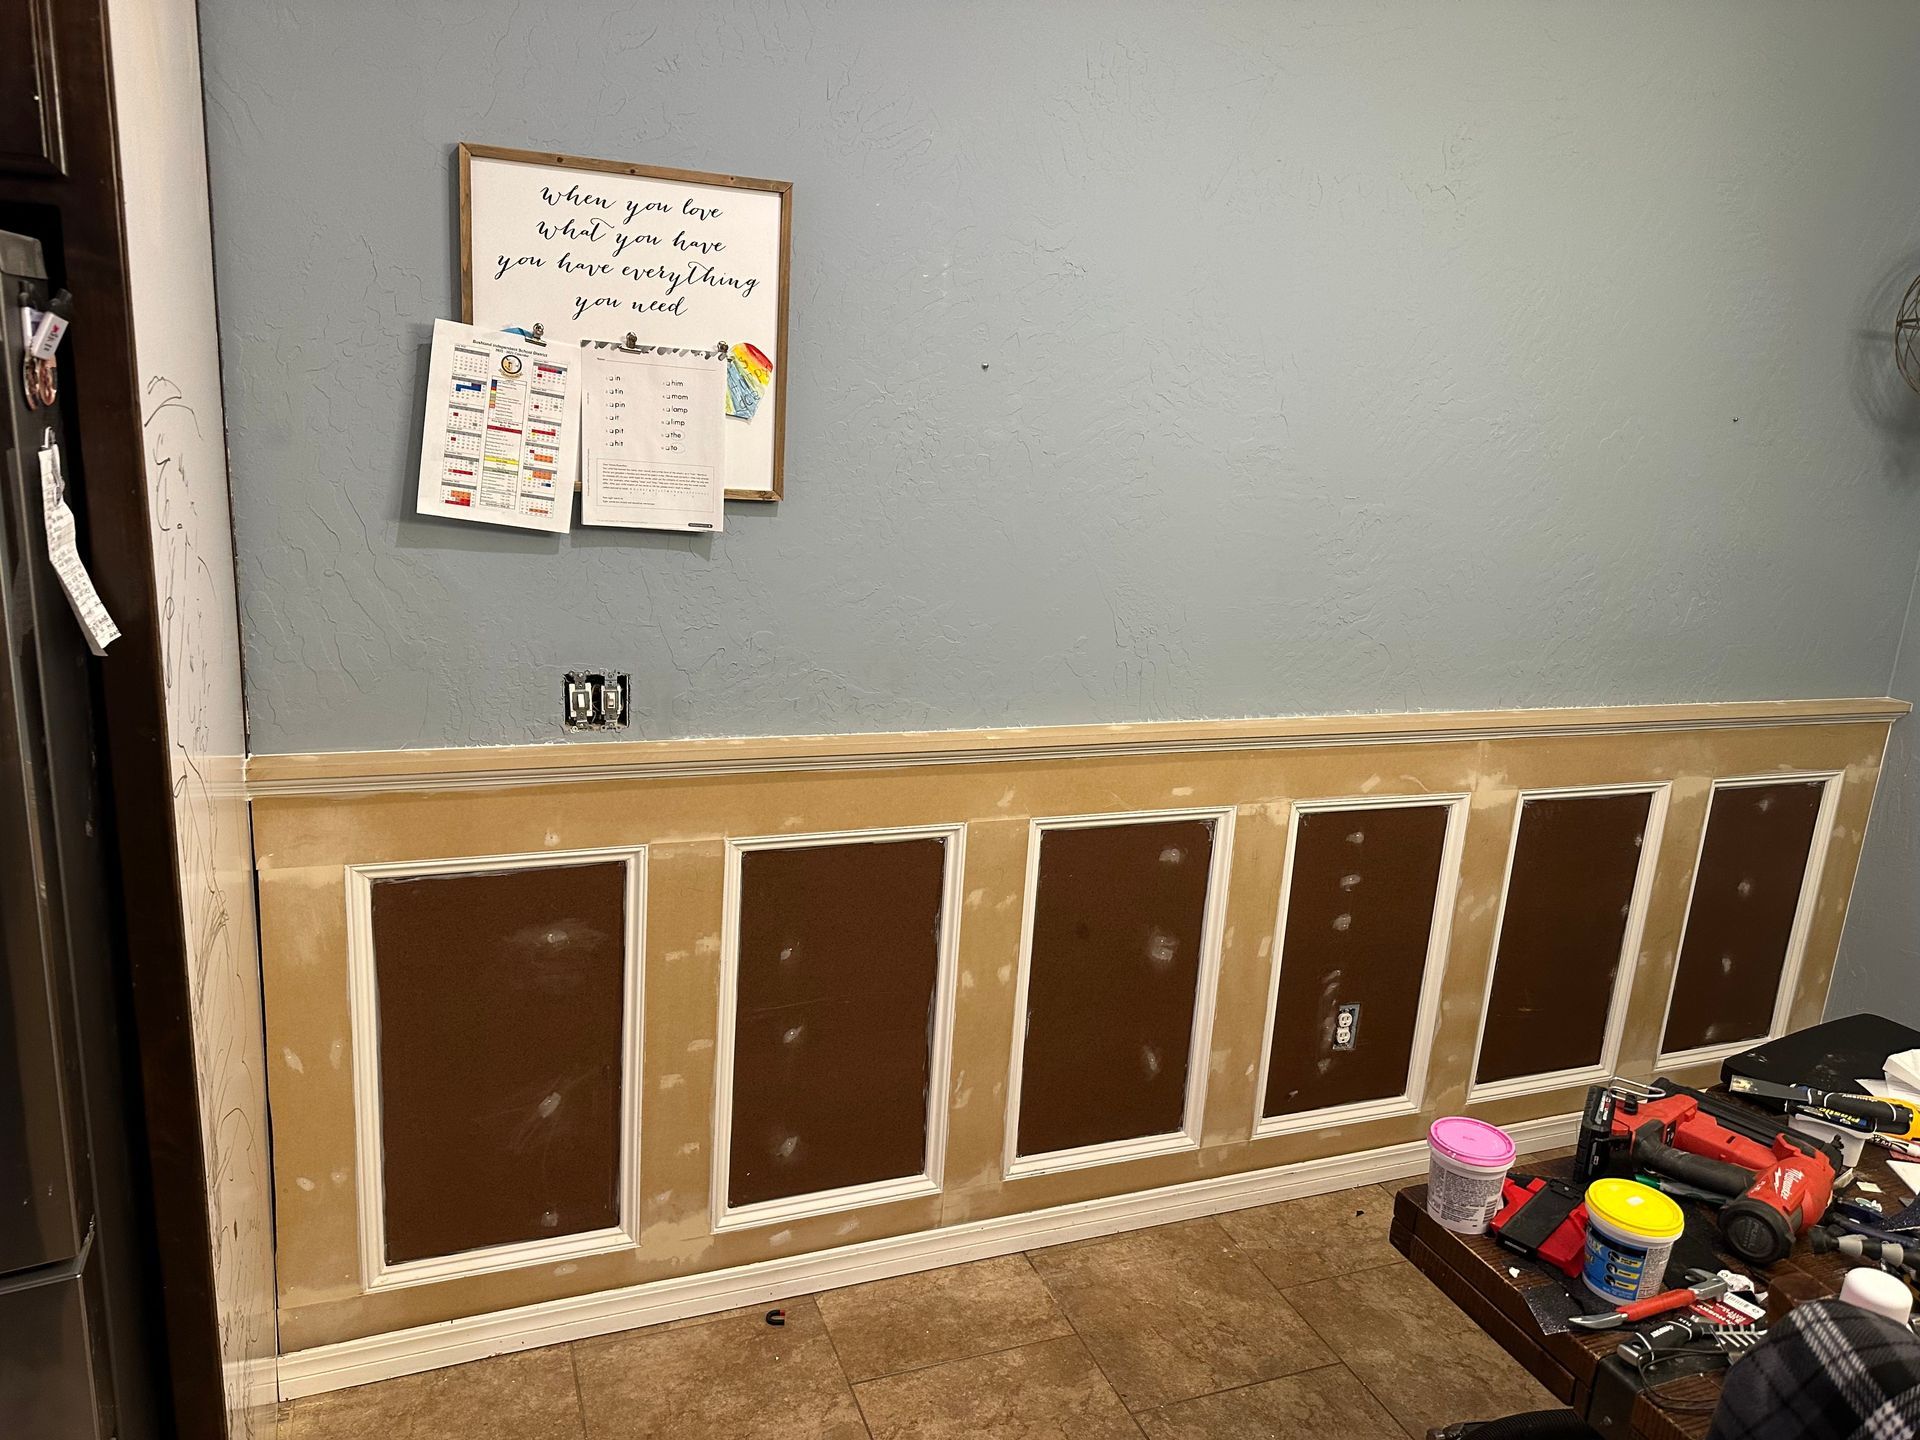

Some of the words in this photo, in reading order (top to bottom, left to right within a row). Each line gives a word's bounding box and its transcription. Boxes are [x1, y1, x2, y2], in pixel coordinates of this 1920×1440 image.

[539, 184, 616, 209] when
[622, 199, 673, 225] you
[682, 199, 724, 222] love
[535, 217, 615, 241] what
[611, 232, 663, 257] you
[672, 230, 727, 254] have
[494, 254, 547, 280] you
[557, 252, 614, 276] have
[621, 261, 760, 298] everything
[571, 295, 622, 321] you
[631, 296, 688, 317] need
[671, 379, 684, 387] him
[671, 405, 689, 414] lamp
